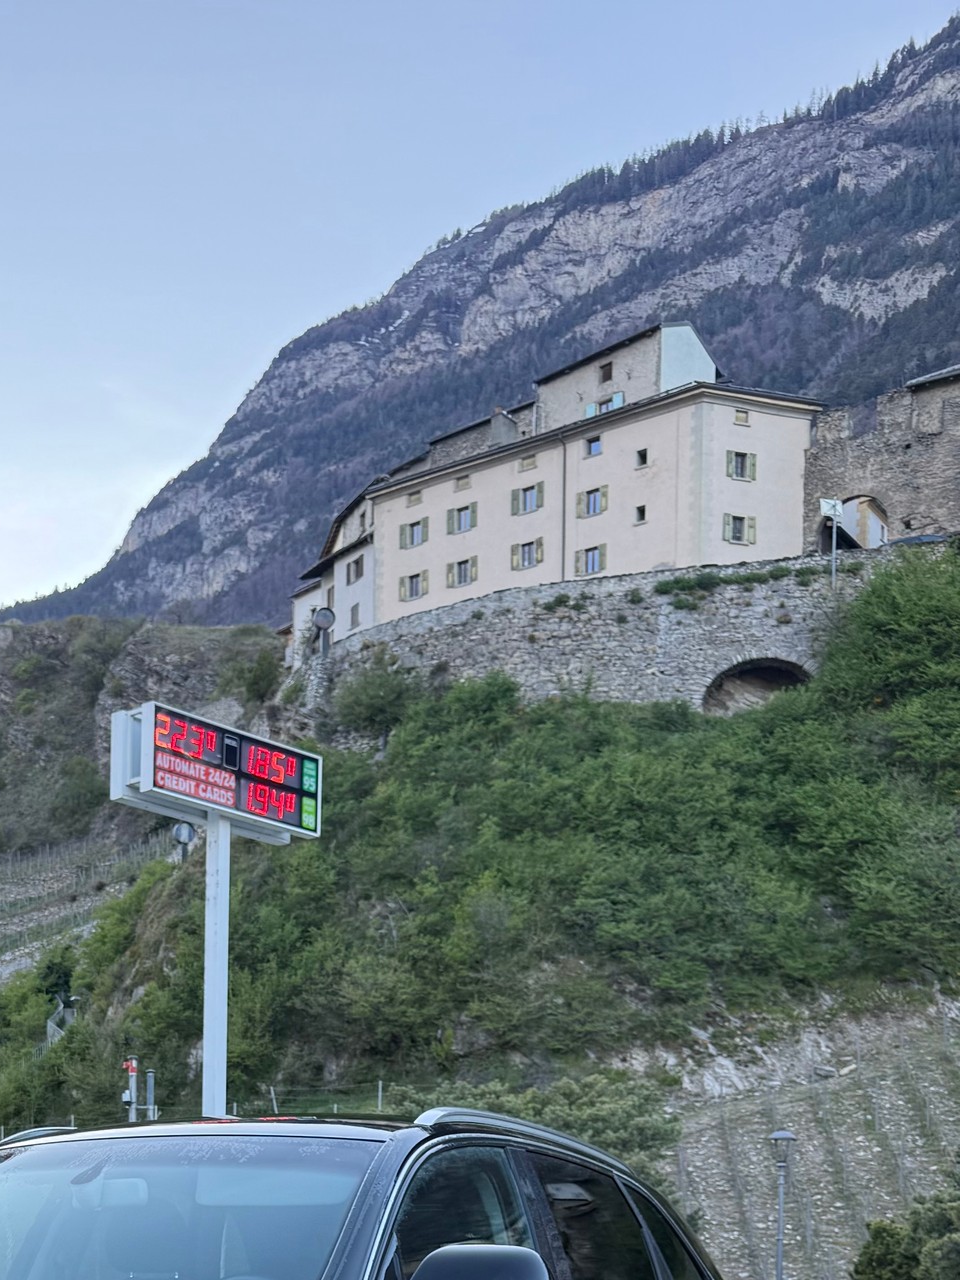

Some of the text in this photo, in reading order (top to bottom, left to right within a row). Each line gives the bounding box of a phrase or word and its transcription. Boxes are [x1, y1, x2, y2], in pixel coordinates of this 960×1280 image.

[156, 752, 236, 790] AUTOMATE 24/24
[303, 775, 317, 792] 95
[157, 771, 234, 805] CREDIT CARDS
[302, 813, 316, 830] 98
